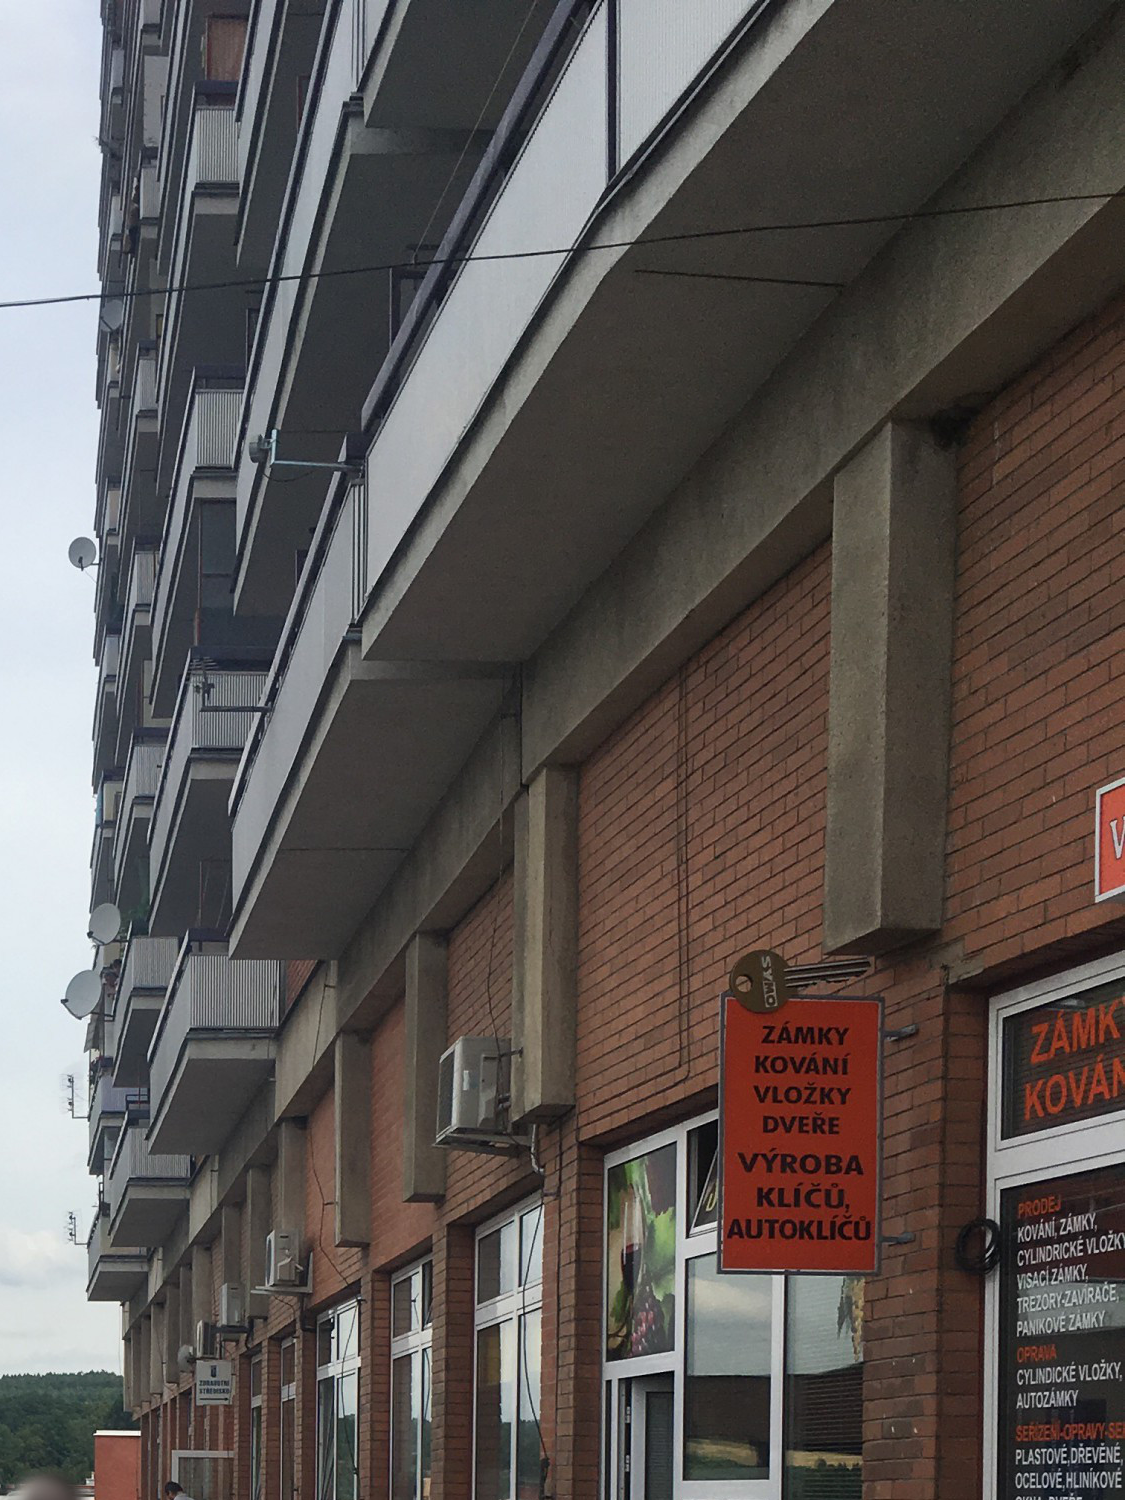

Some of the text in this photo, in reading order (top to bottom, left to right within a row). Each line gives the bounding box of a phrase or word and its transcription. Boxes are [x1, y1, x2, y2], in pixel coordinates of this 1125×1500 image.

[761, 955, 778, 1008] SYMO
[761, 1021, 849, 1046] ZÁMKY
[1030, 995, 1125, 1064] ZÁMK
[754, 1052, 849, 1076] KOVÁNÍ
[753, 1082, 852, 1105] VLOŽKY
[762, 1112, 840, 1135] DVEŘE
[737, 1149, 864, 1176] VÝROBA
[756, 1183, 850, 1213] KLÍČŮ,
[1017, 1194, 1062, 1219] PRODEJ
[727, 1214, 872, 1242] AUTOKLÍČŮ
[1017, 1213, 1097, 1243] KOVÁNÍ, ZÁMKY,
[1017, 1236, 1084, 1266] CYLINDRICKÉ
[1017, 1263, 1088, 1290] VISACÍ ZÁMKY,
[1017, 1310, 1105, 1337] PANIKOVÉ ZÁMKY
[1017, 1344, 1057, 1363] OPRAVA
[1017, 1359, 1123, 1385] CYLINDICKÉ VLOŽKY,
[1016, 1387, 1079, 1409] AUTOZÁMKY
